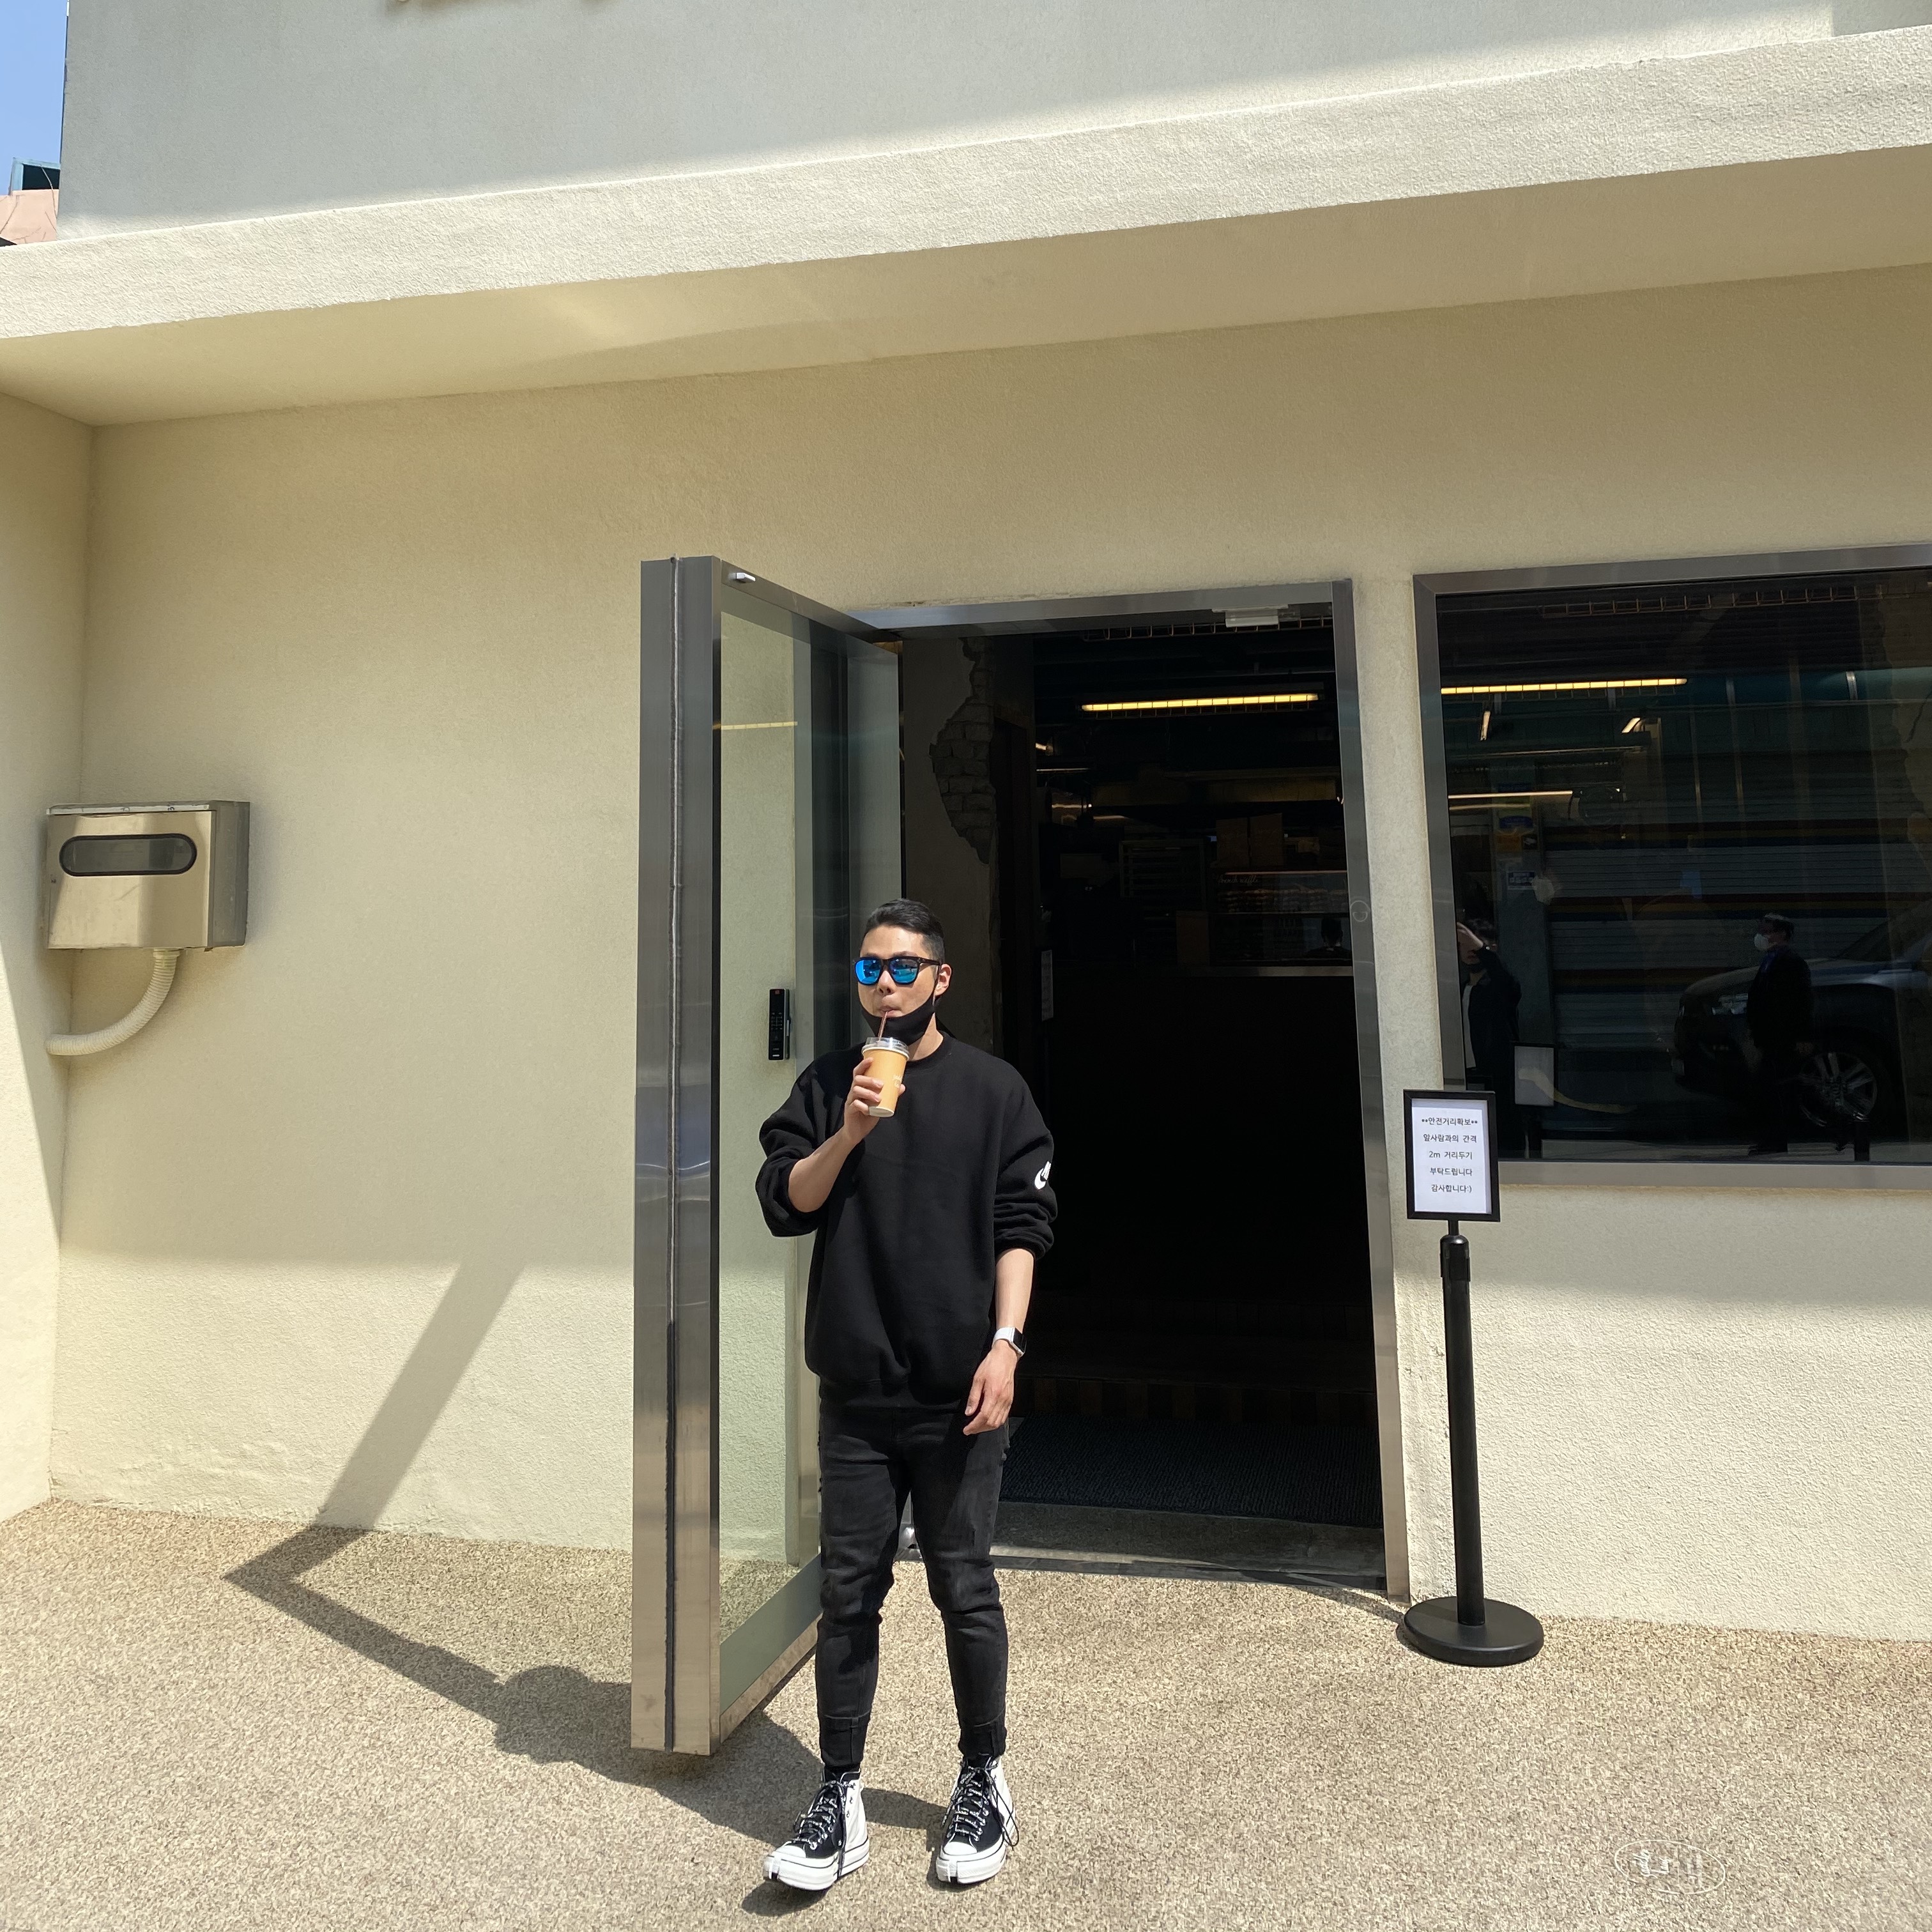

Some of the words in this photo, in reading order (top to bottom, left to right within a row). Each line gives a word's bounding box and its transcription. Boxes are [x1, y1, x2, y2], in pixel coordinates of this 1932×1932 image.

[1423, 1133, 1459, 1142] 앞사람과의
[1462, 1135, 1477, 1143] 간격
[1444, 1151, 1473, 1160] 거리두기
[1430, 1167, 1473, 1176] 부탁드립니다
[1431, 1184, 1472, 1193] 감사합니다:)
